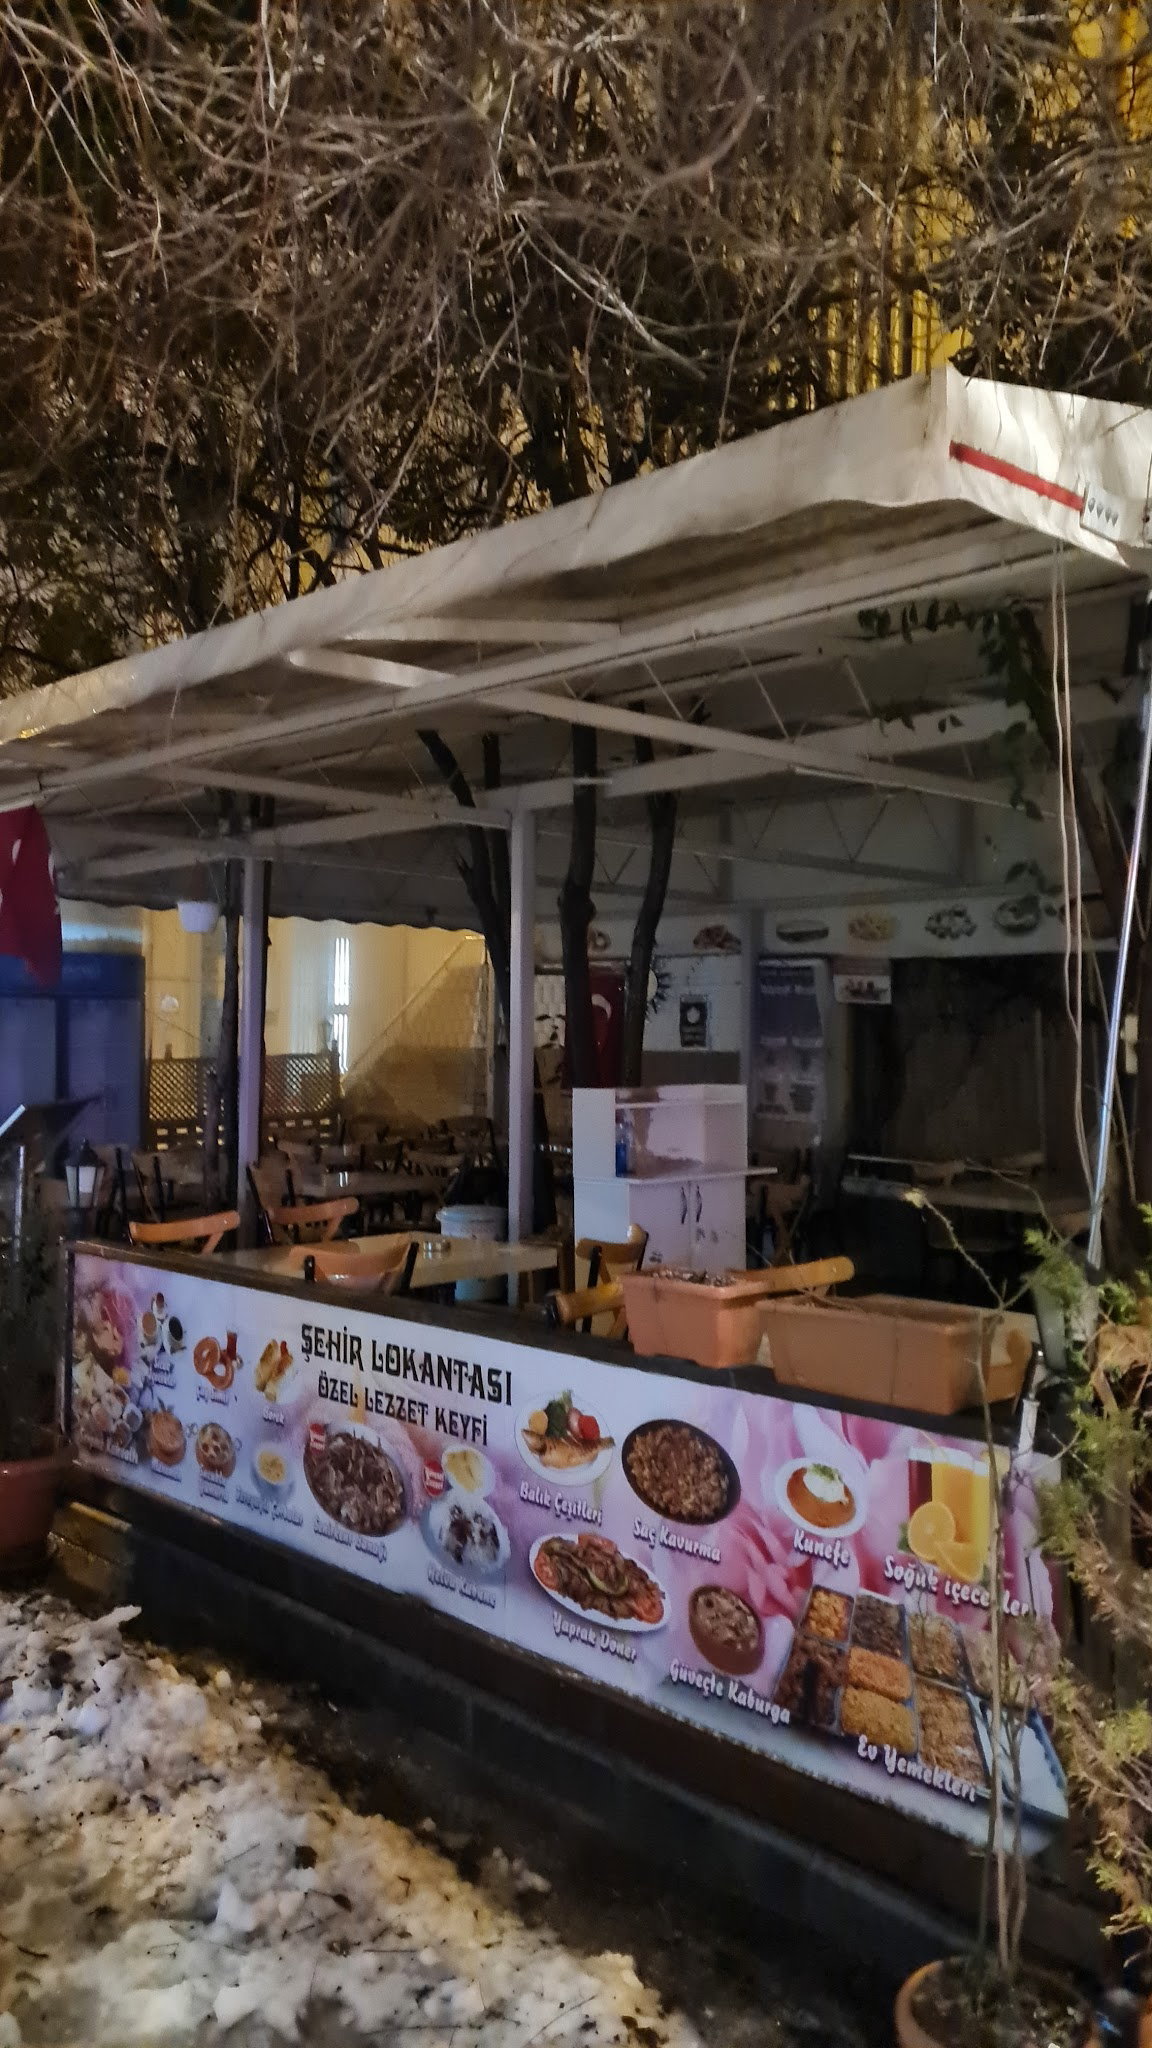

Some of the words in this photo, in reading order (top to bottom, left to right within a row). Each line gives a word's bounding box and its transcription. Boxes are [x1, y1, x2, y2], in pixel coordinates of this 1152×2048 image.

[301, 1323, 364, 1372] ŞEHİR
[371, 1339, 512, 1406] LOKANTASI
[318, 1370, 358, 1408] ÖZEL
[364, 1387, 429, 1427] LEZZET
[435, 1405, 488, 1446] KEYFİ
[520, 1481, 551, 1508] Balık
[659, 1524, 722, 1563] Kavurma
[944, 1575, 1030, 1617] içeceler
[553, 1611, 596, 1646] Yaprak
[728, 1681, 791, 1724] Kaburga
[857, 1734, 878, 1761] Ev
